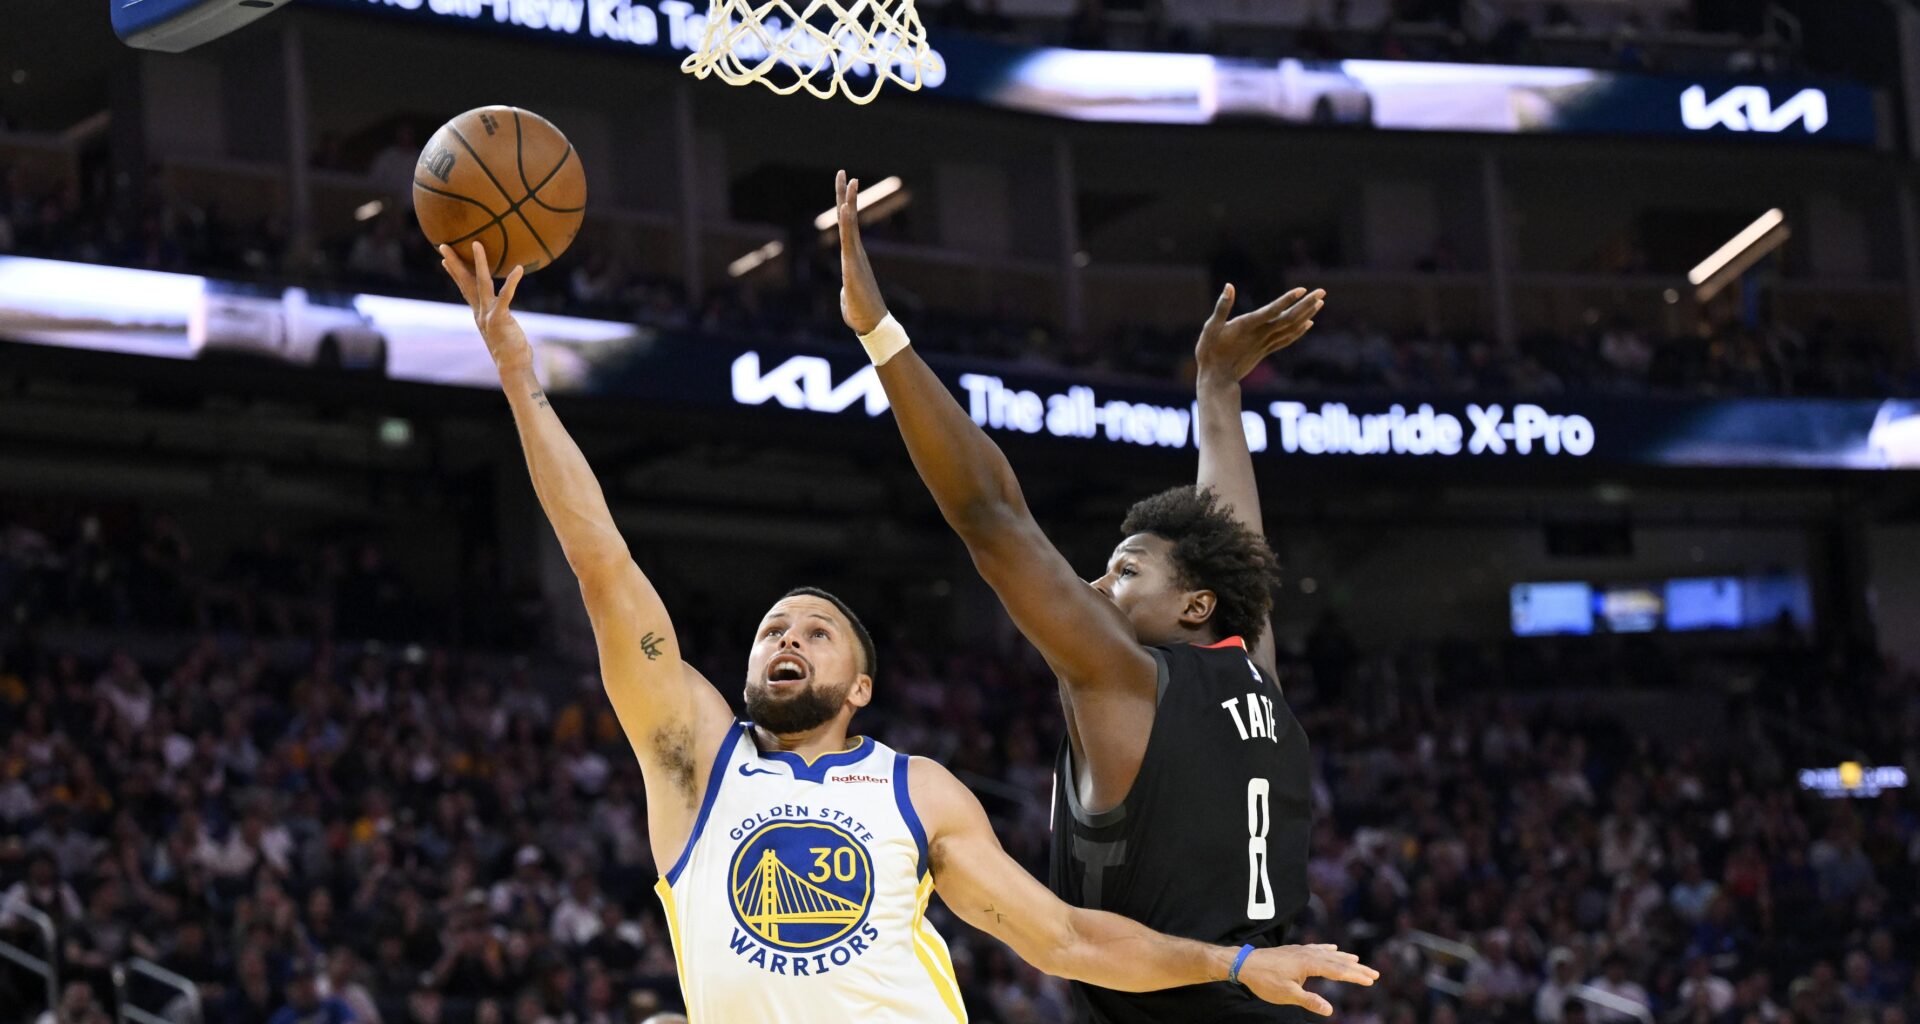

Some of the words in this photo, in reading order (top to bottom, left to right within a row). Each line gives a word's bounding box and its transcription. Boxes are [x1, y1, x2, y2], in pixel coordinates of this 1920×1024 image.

[1680, 84, 1829, 134] KIA
[959, 372, 1044, 434] The
[1046, 385, 1190, 448] all-new
[1269, 401, 1463, 455] Telluride
[1465, 403, 1595, 456] X-Pro
[1221, 693, 1278, 743] TATE
[831, 774, 889, 784] Rakuten
[729, 804, 809, 841] GOLDEN
[819, 807, 874, 843] STATE
[807, 846, 857, 883] 30
[1247, 778, 1275, 920] 8
[729, 922, 879, 976] WARRIORS
